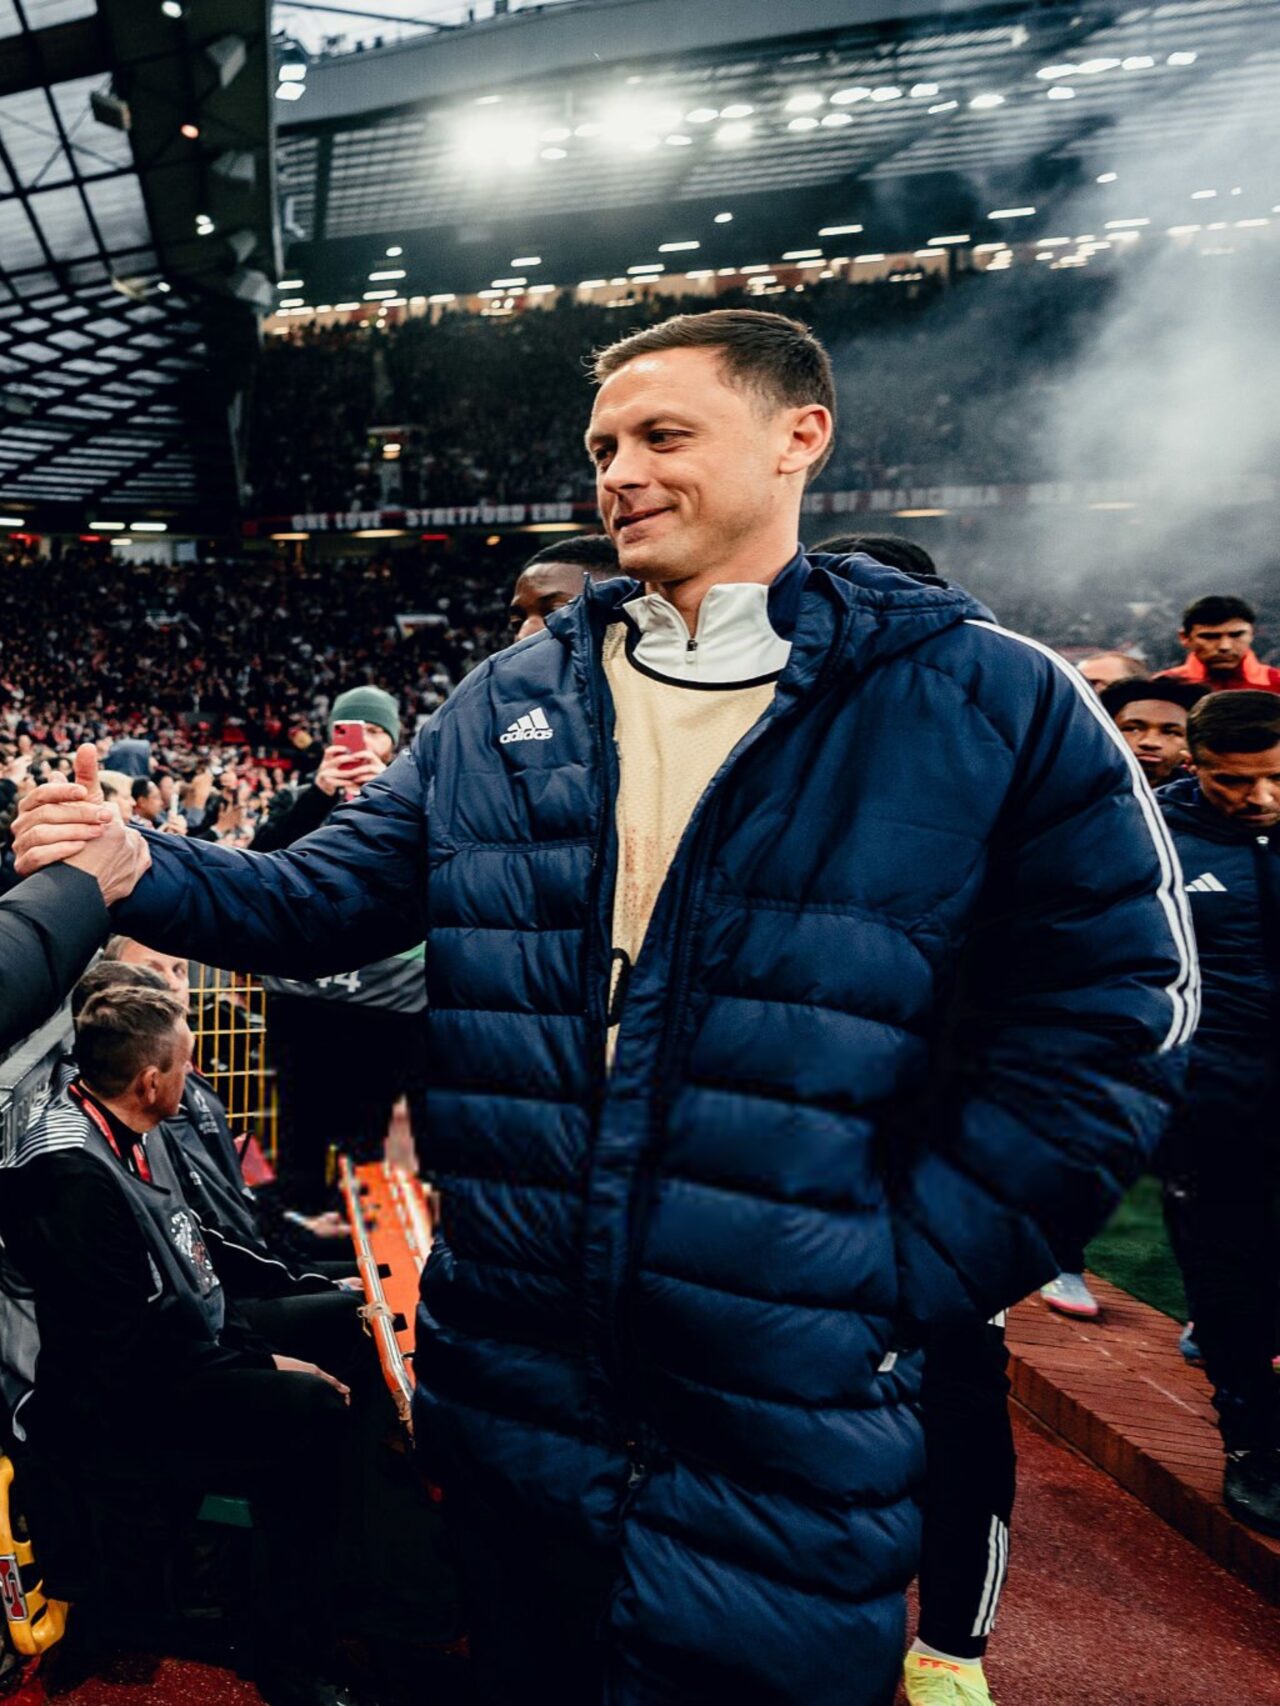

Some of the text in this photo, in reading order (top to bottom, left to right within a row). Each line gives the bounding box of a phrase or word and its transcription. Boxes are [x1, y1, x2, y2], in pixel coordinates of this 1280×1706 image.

[291, 503, 574, 530] ONE LOVE STRETFORD END
[499, 728, 554, 744] adidas
